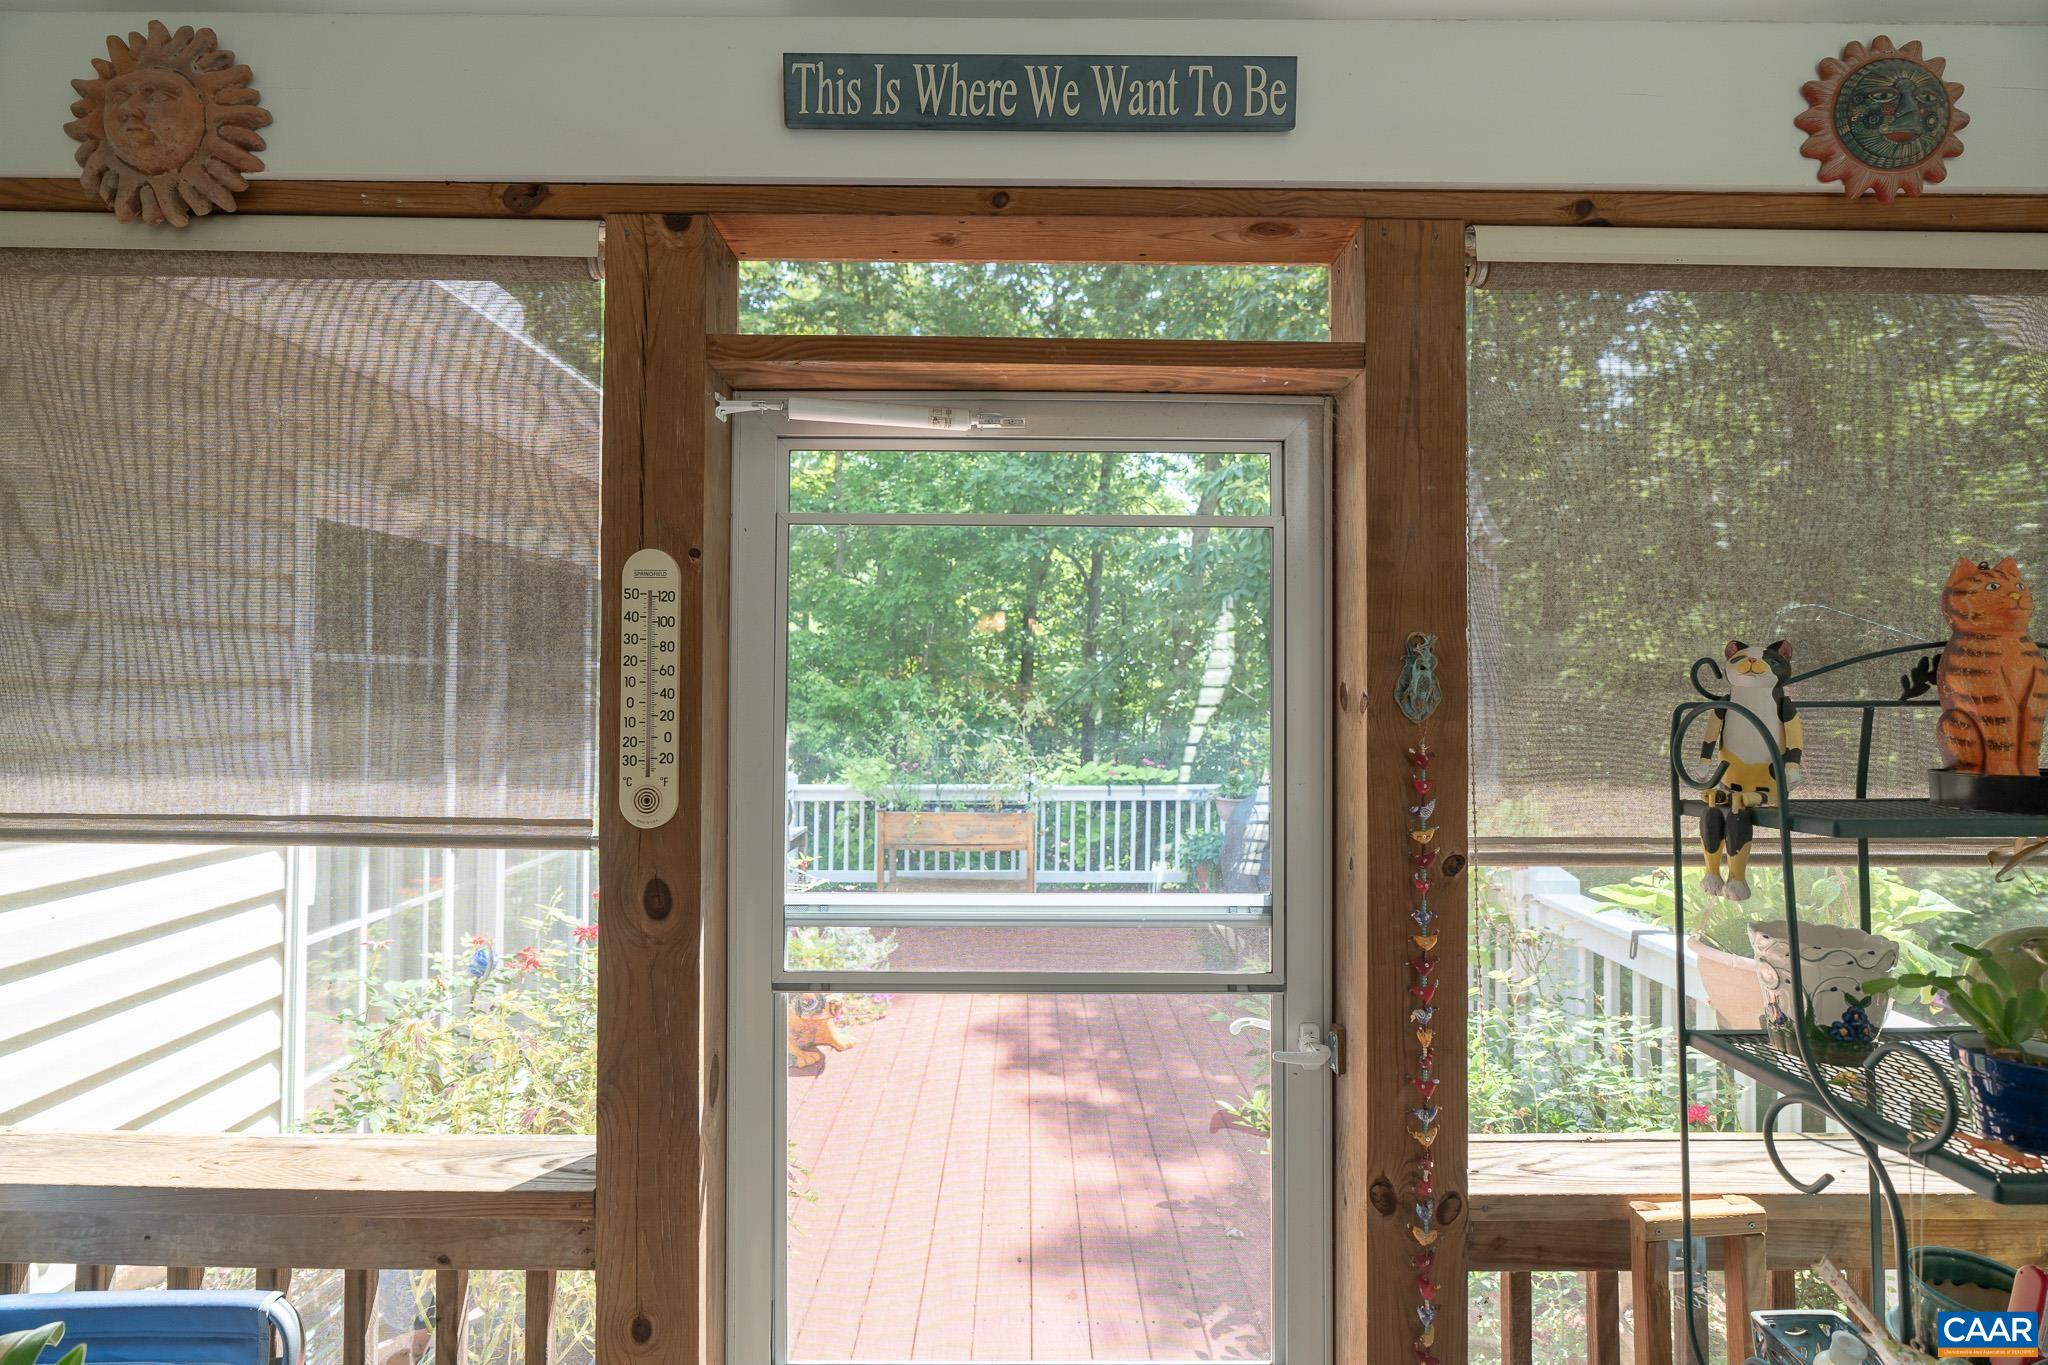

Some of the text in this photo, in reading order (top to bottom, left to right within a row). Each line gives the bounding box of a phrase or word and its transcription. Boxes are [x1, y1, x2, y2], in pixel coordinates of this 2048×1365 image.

[791, 61, 1287, 119] This Is Where We Want To Be
[623, 588, 640, 600] 50
[657, 590, 676, 602] 120
[623, 611, 640, 622] 40
[657, 616, 676, 627] 100
[623, 633, 639, 644] 30
[660, 641, 675, 652] 80
[623, 655, 638, 666] 20
[659, 665, 675, 676] 60
[624, 676, 636, 688] 10
[659, 688, 675, 699] 40
[626, 696, 635, 708] 0
[659, 710, 675, 721] 20
[623, 716, 636, 728] 10
[622, 736, 638, 748] 20
[664, 732, 672, 742] 0
[622, 755, 638, 766] 30
[659, 752, 674, 764] 20
